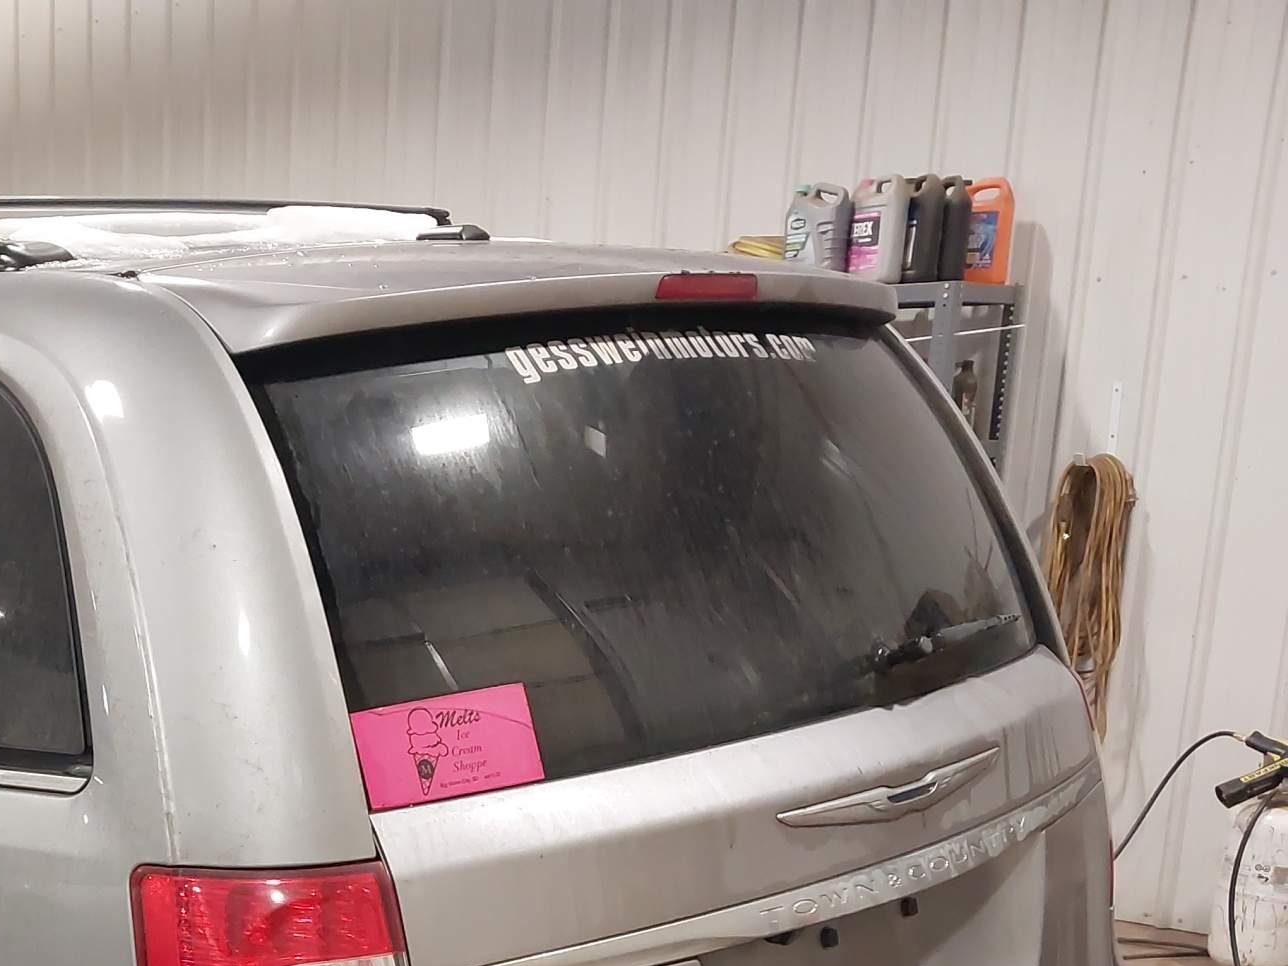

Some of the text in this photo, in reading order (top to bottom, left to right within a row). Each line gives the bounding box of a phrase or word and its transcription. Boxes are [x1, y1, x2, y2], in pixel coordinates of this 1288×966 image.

[505, 325, 817, 384] gessweinmotors.com
[435, 709, 481, 728] Melts
[456, 729, 470, 741] Ice
